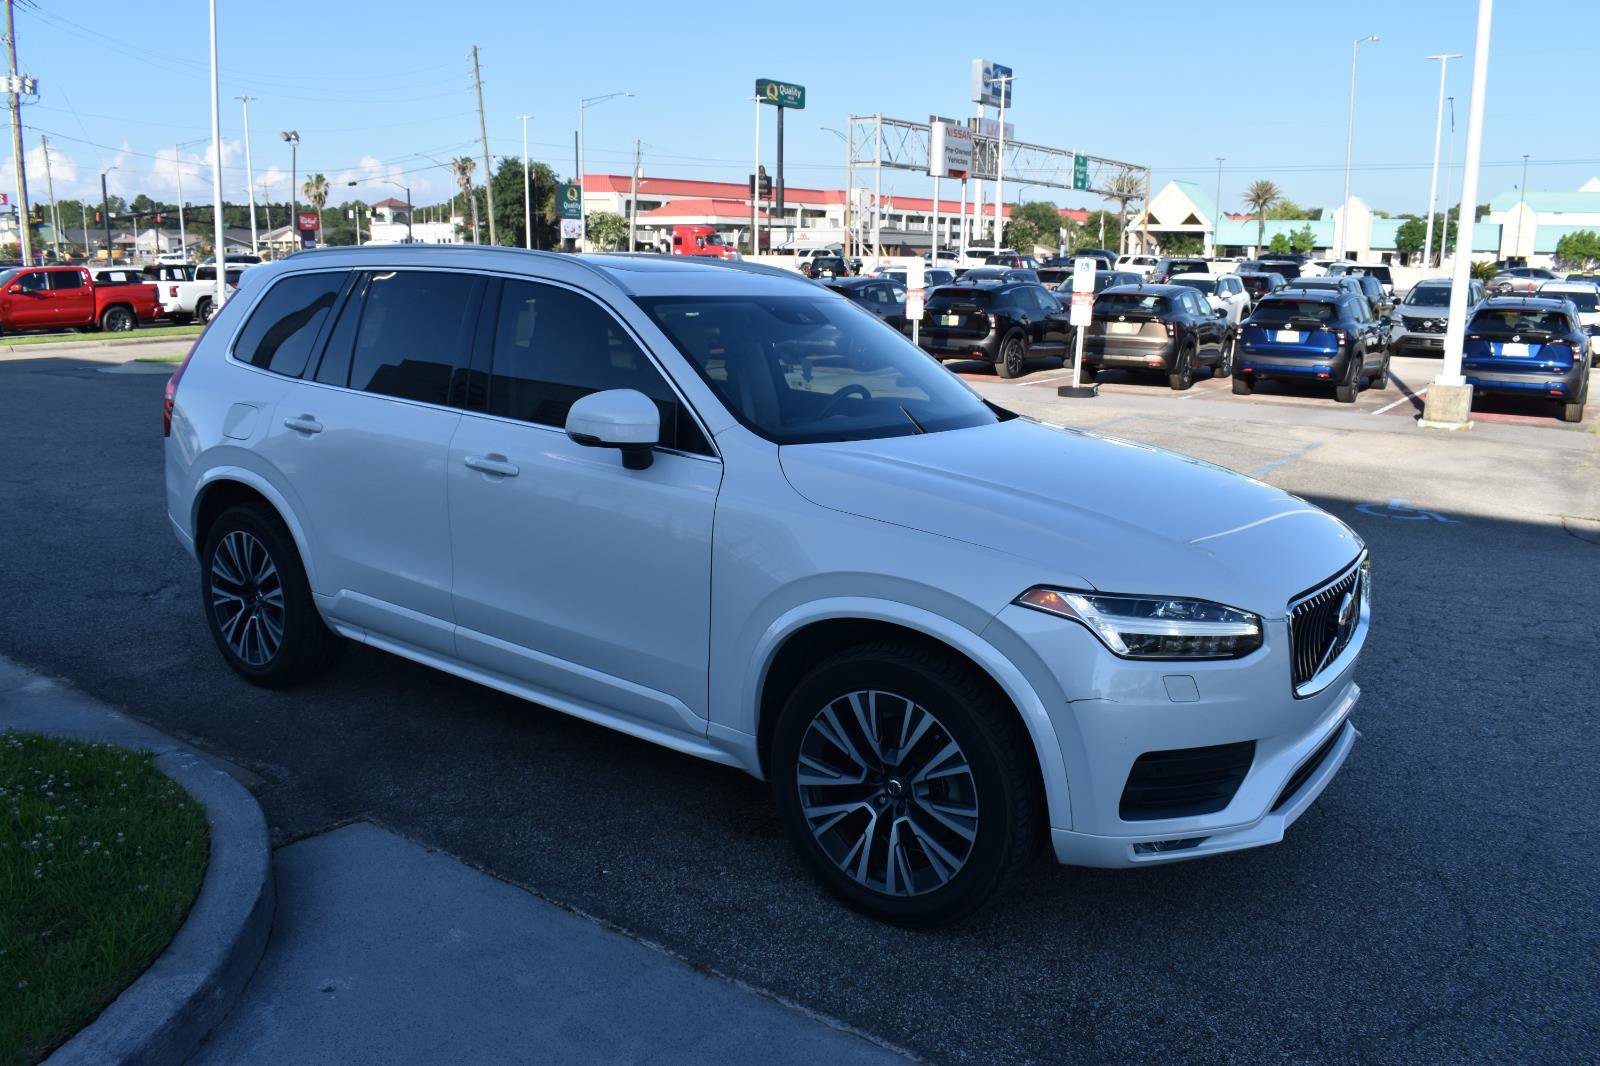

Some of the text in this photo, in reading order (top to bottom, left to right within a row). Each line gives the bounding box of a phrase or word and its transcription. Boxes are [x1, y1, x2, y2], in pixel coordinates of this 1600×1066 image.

[780, 85, 801, 99] Quality
[945, 127, 972, 140] NISSAN
[945, 146, 972, 157] Pre-Owned
[947, 155, 968, 165] Vehicles
[564, 201, 581, 210] Quality
